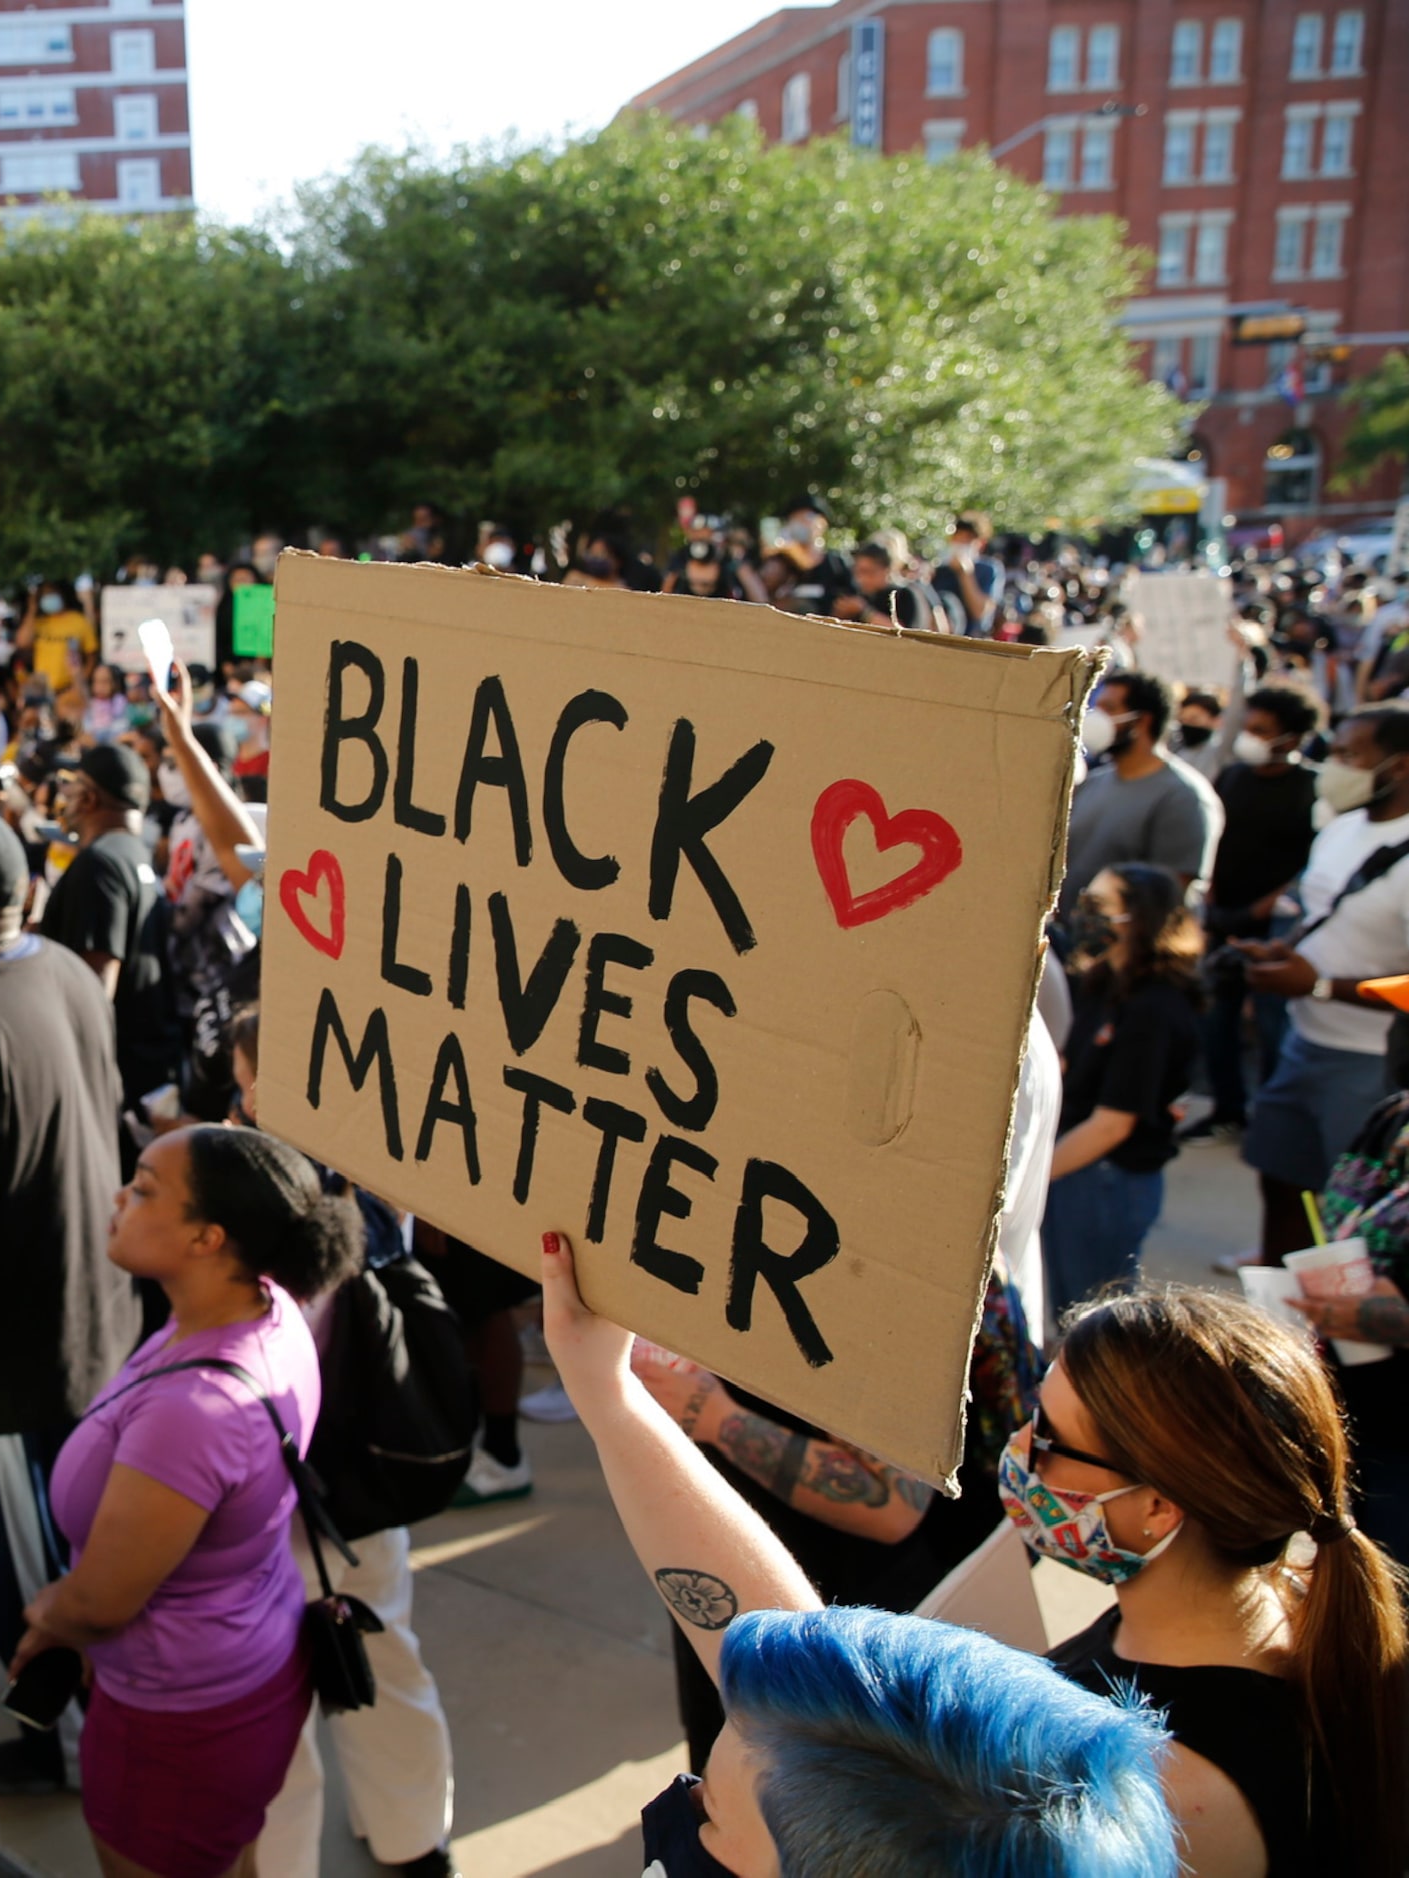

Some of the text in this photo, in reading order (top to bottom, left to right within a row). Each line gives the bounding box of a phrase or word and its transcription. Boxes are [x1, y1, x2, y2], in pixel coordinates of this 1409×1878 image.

[321, 640, 775, 954] BLACK
[382, 853, 737, 1132] LIVES
[307, 989, 840, 1368] MATTER
